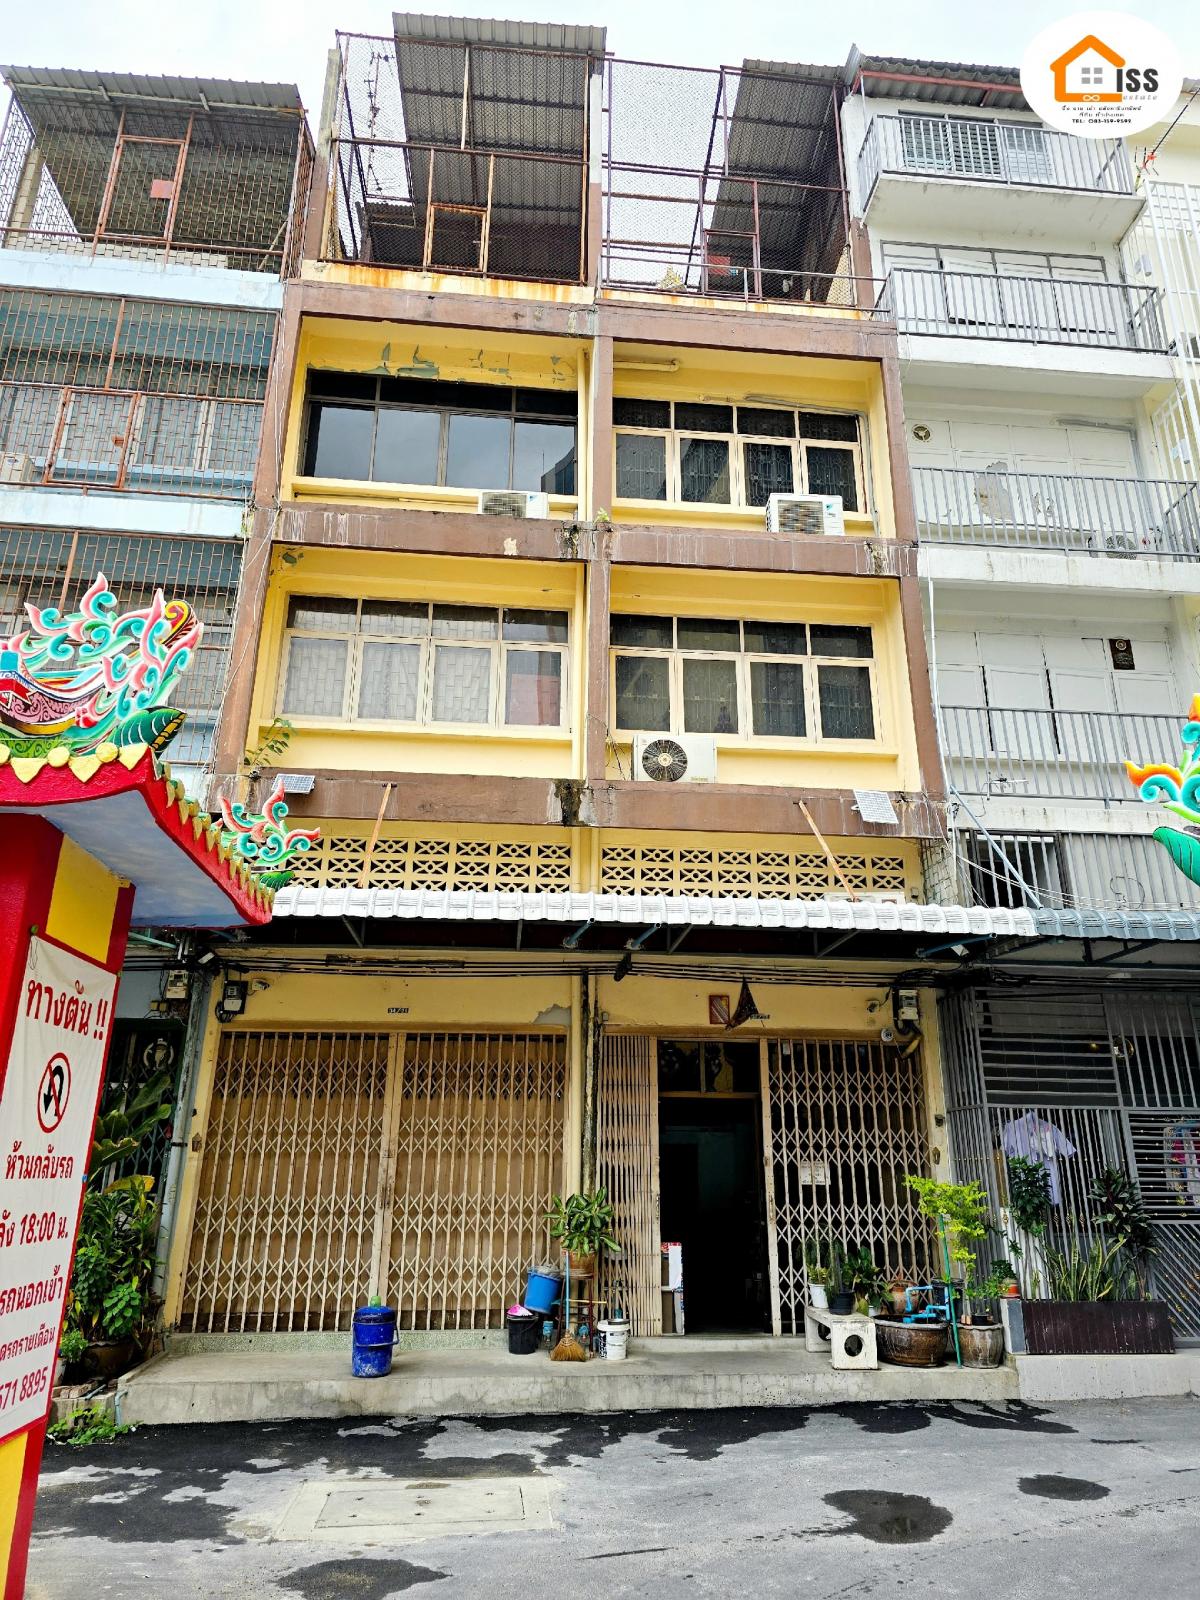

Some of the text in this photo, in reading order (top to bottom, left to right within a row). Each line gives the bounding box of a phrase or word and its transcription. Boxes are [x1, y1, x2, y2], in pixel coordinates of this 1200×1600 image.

[26, 979, 92, 1036] ทางตัน
[5, 1140, 74, 1180] ห้ามกลับรถ
[19, 1366, 48, 1402] 8895
